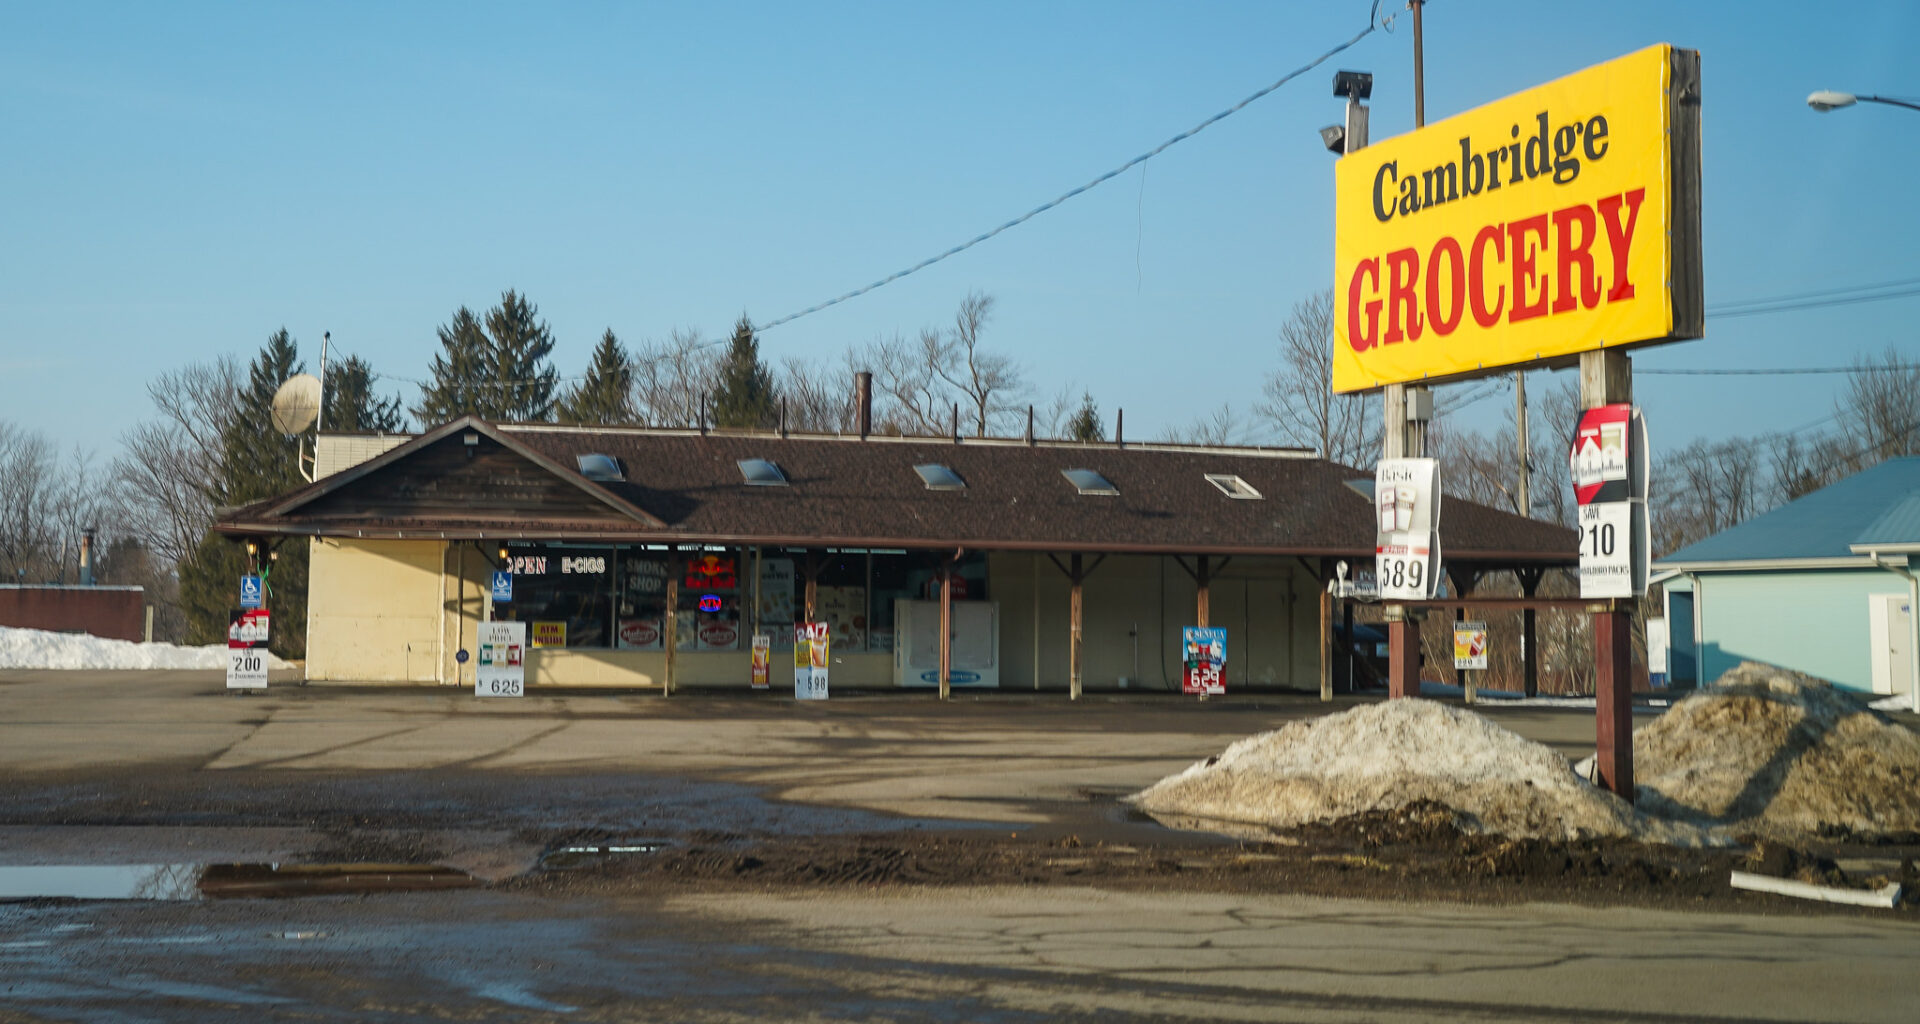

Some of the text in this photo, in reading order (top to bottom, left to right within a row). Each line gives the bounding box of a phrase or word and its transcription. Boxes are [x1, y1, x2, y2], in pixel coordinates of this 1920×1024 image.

[1372, 111, 1609, 222] Cambridge
[1348, 187, 1646, 353] GROCERY
[1583, 505, 1600, 520] SAVE
[561, 556, 606, 574] E-CIGS
[1383, 558, 1423, 589] 589
[629, 575, 662, 592] SHOP
[686, 575, 736, 589] Red Bull
[699, 597, 722, 610] ATM
[540, 625, 559, 635] ATM
[491, 678, 520, 695] 625
[1191, 668, 1220, 688] 629
